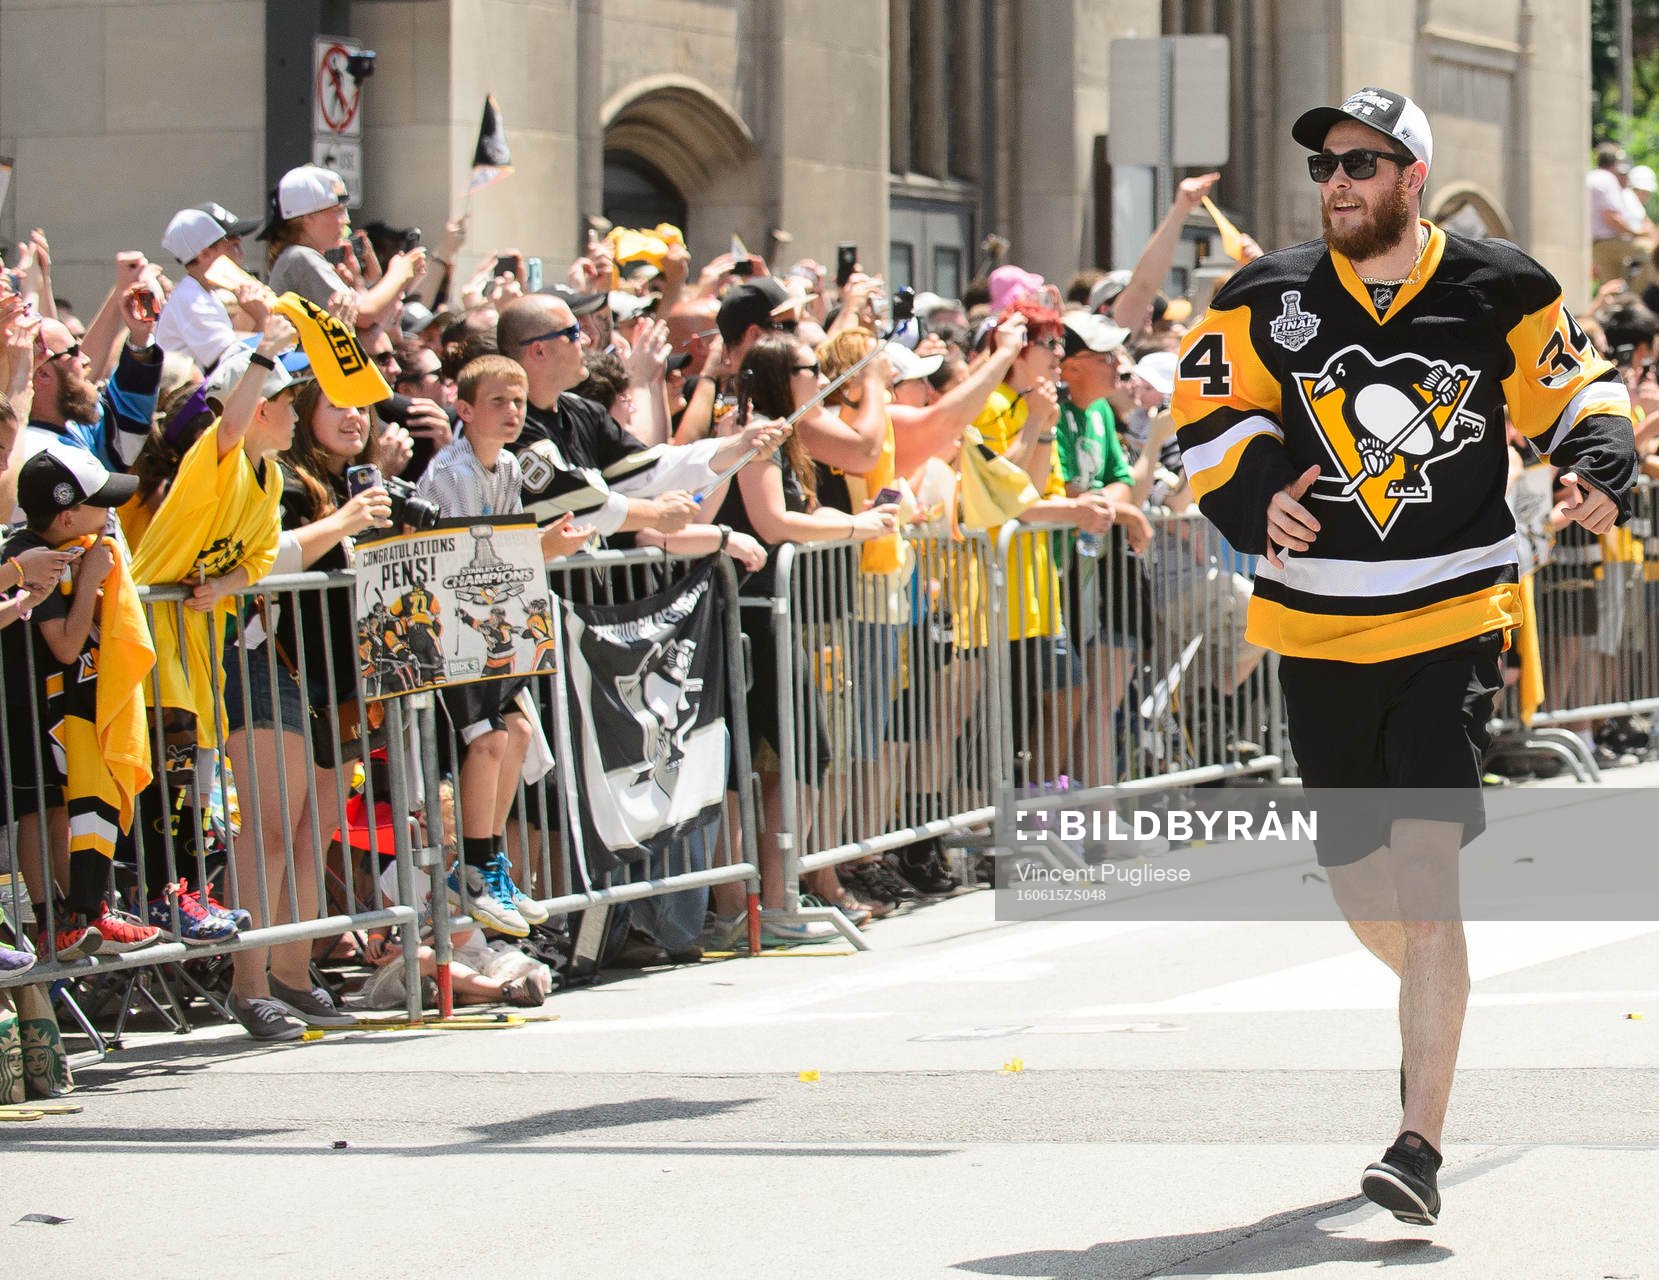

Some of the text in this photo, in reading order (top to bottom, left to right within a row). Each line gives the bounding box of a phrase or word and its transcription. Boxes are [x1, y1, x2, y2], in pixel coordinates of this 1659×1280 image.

[1275, 319, 1315, 334] FINAL
[1179, 333, 1231, 396] 4
[363, 538, 455, 567] CONGRATULATIONS
[382, 556, 435, 591] PENS!
[443, 569, 534, 589] CHAMPIONS
